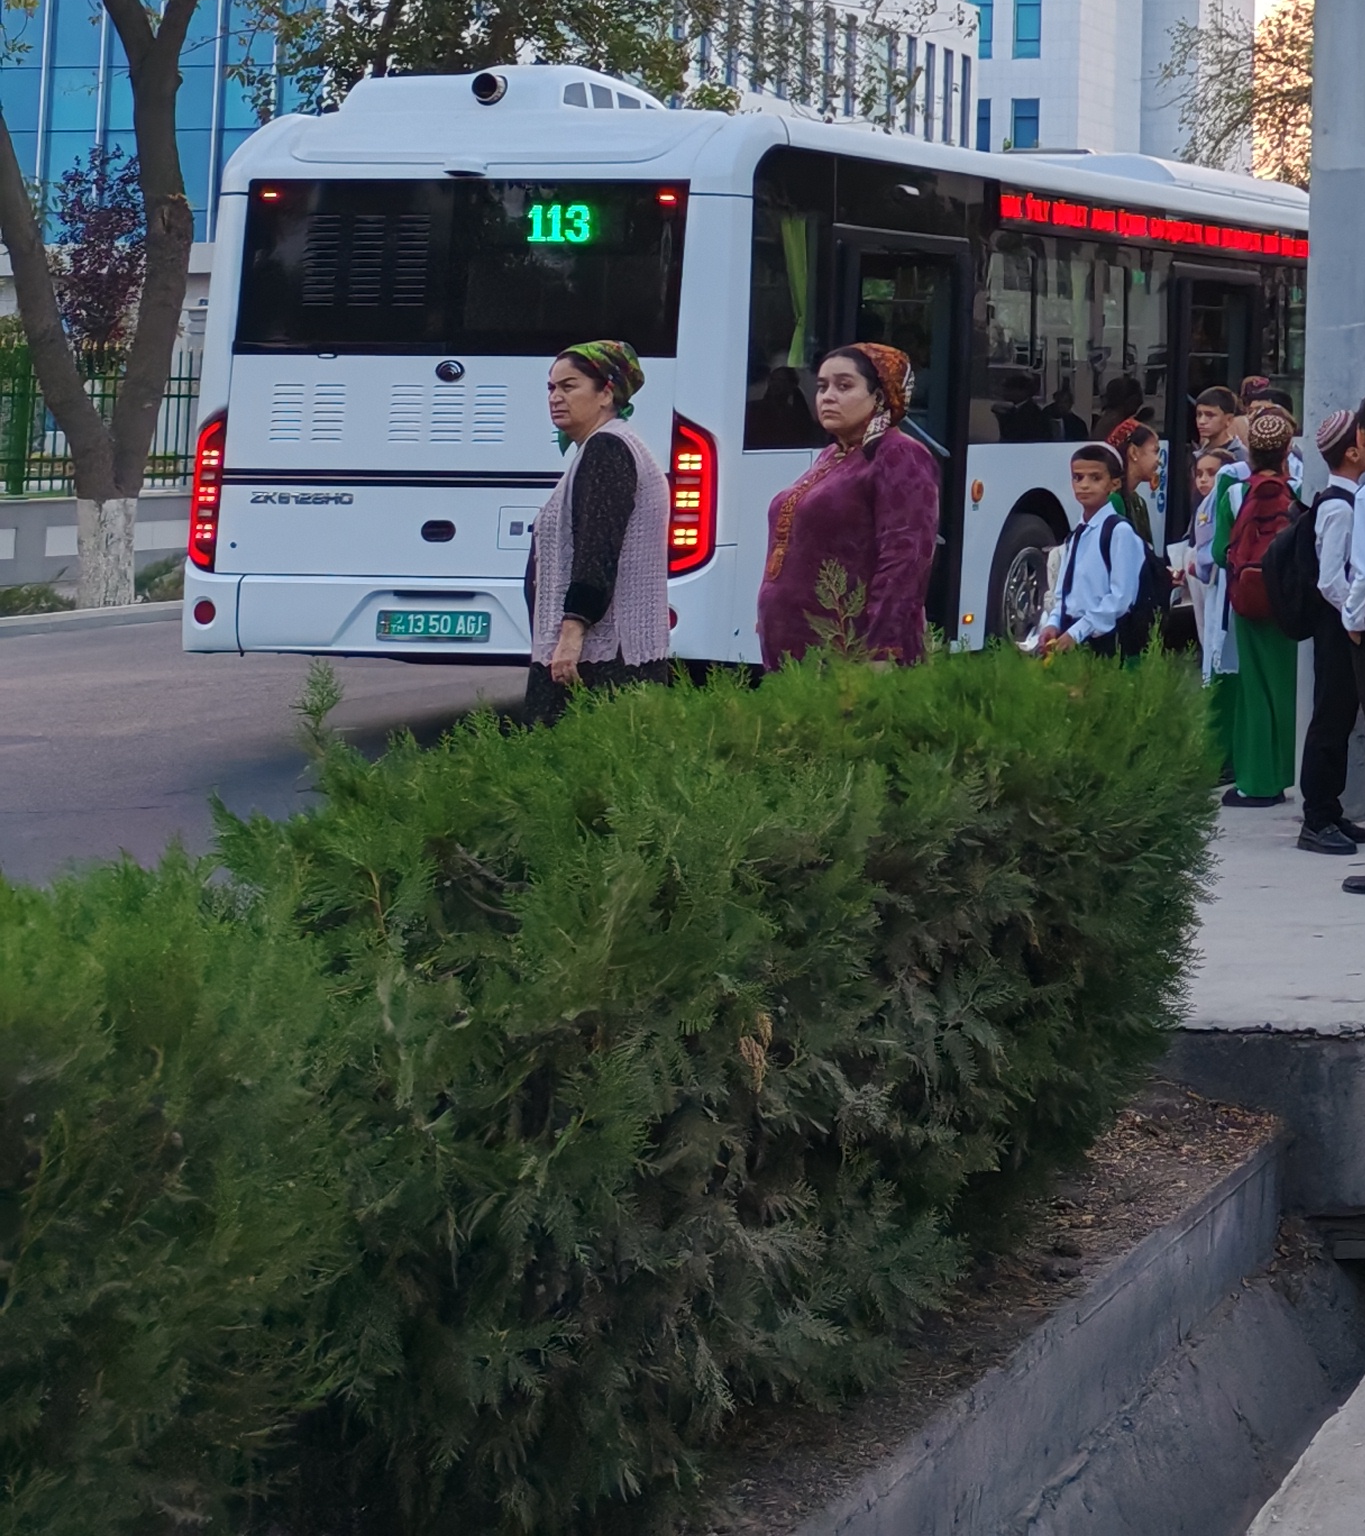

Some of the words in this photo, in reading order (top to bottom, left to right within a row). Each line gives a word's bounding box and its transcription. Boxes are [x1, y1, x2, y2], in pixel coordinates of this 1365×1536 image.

[527, 204, 590, 242] 113
[407, 614, 425, 633] 13
[428, 614, 451, 634] 50
